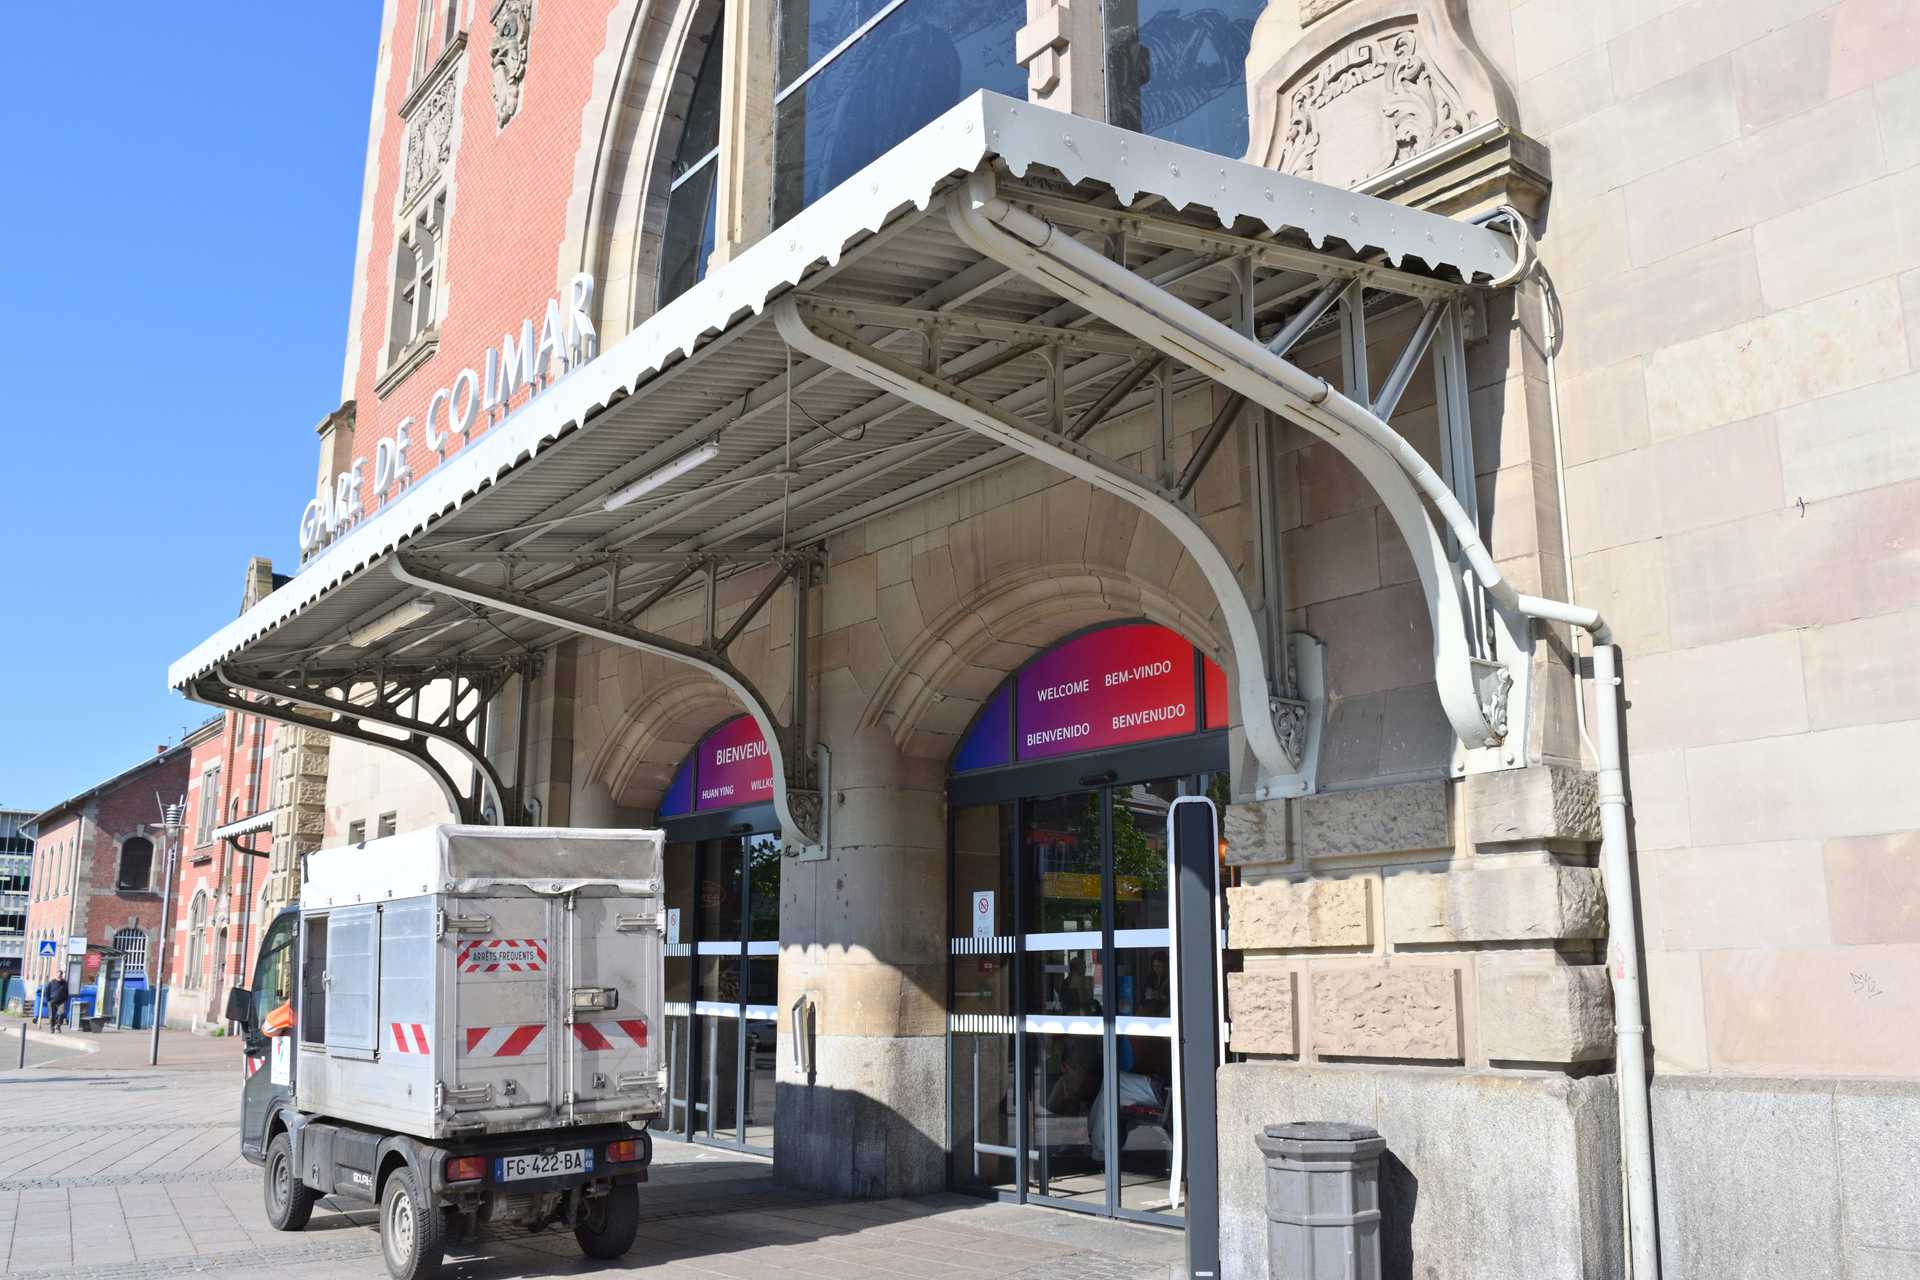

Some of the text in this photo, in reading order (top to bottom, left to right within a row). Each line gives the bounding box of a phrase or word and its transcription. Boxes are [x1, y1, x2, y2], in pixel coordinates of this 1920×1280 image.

[300, 272, 596, 549] GARE DE COLMAR
[1105, 660, 1172, 687] BEM-VINDO
[1037, 679, 1089, 702] WELCOME
[1112, 703, 1185, 729] BENVENUDO
[1027, 722, 1090, 746] BIENVENIDO
[716, 740, 769, 765] BIENVENU
[702, 785, 734, 800] HUAN YING
[507, 1152, 582, 1176] FG-422-BA
